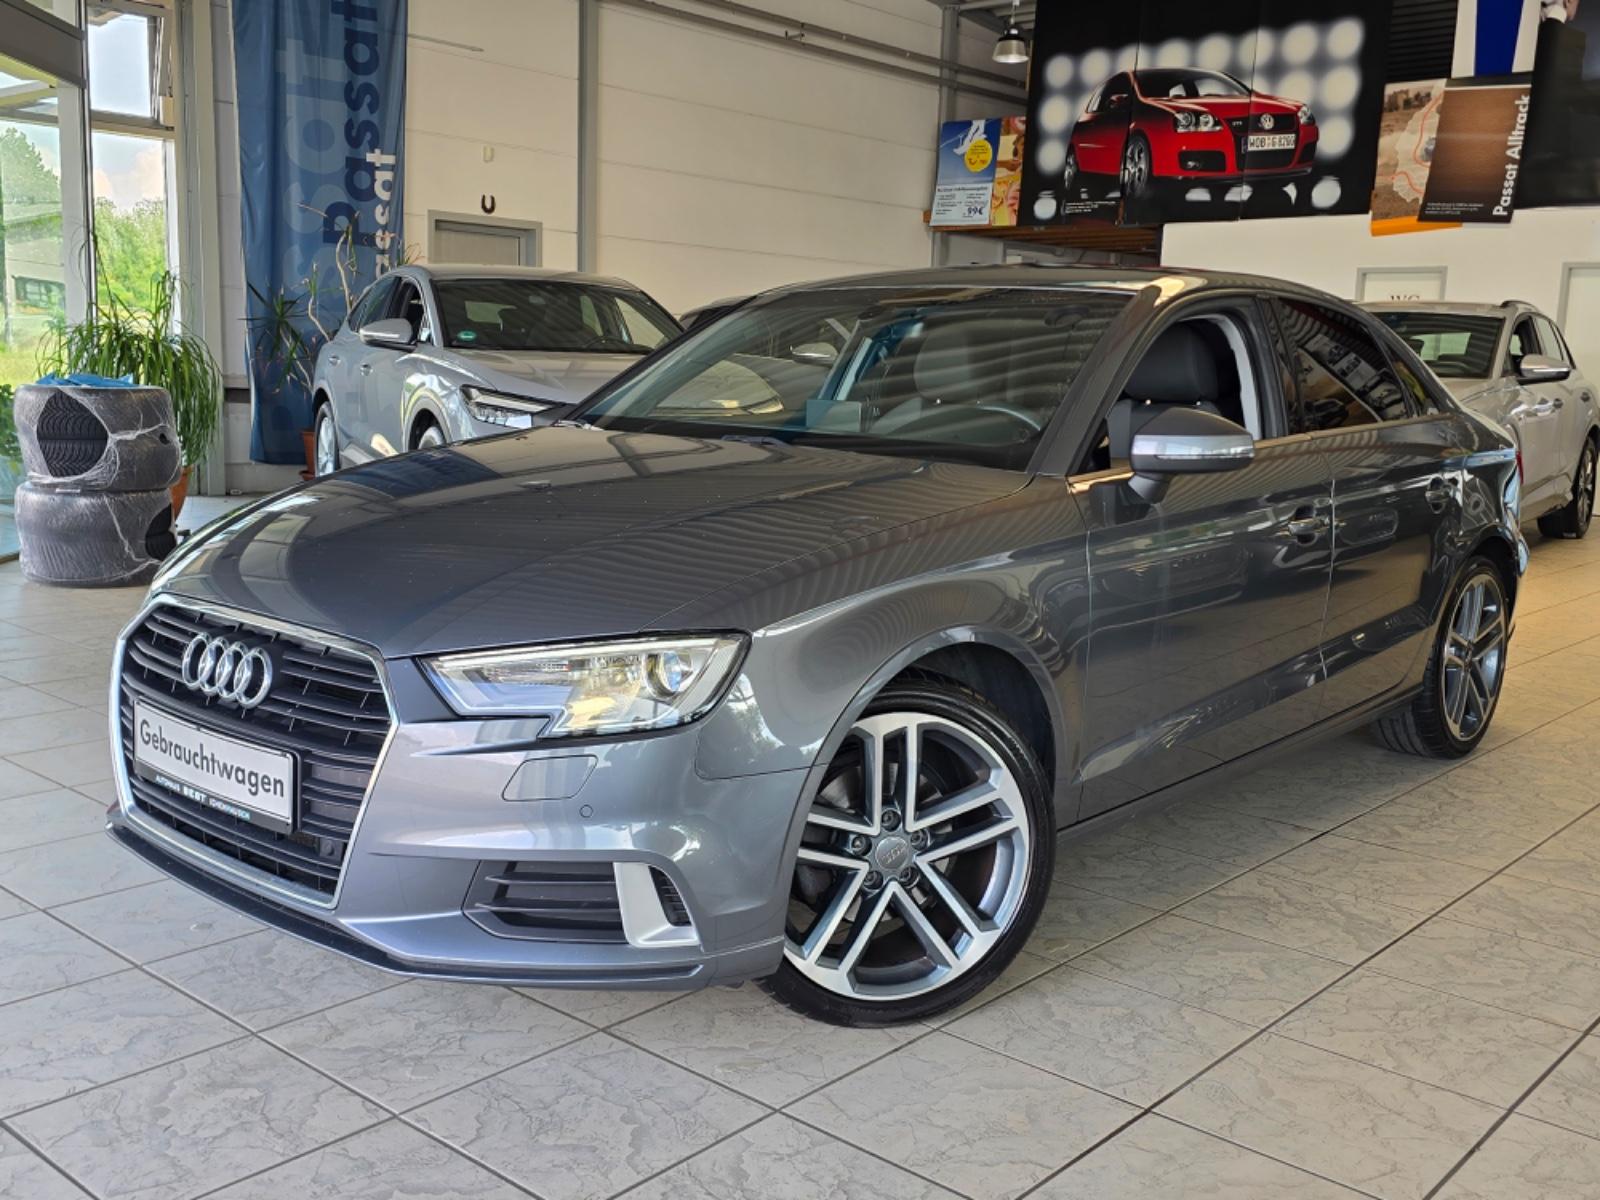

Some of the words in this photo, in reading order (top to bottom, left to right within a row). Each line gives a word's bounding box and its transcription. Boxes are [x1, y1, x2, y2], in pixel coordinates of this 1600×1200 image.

[1505, 95, 1530, 159] Alltrack
[1492, 163, 1519, 216] Passat
[139, 718, 285, 798] Gebrauchtwagen
